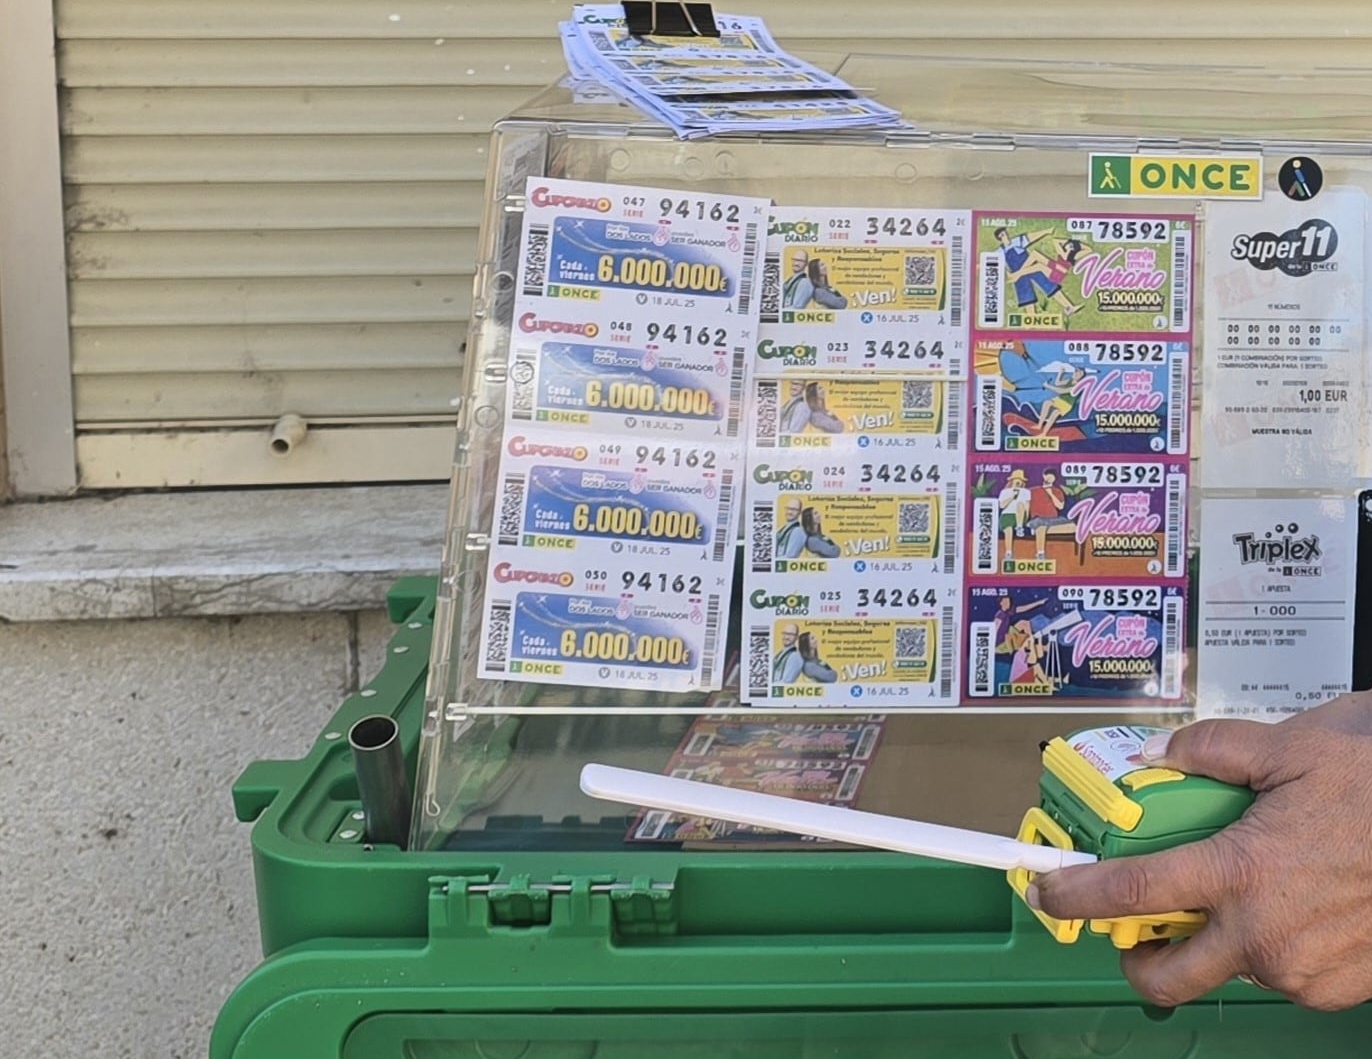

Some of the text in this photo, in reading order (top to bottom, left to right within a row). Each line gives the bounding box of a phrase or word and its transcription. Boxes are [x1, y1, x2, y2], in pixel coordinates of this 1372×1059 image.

[1141, 163, 1250, 190] ONCE
[623, 197, 645, 206] 047
[659, 198, 739, 222] 94162
[829, 220, 851, 228] 022
[867, 217, 946, 236] 34264
[1071, 221, 1092, 229] 087
[1099, 222, 1166, 240] 78592
[598, 255, 728, 292] 6.000.000€
[1073, 248, 1166, 299] Verano
[562, 288, 599, 299] ONCE
[851, 288, 897, 307] ¡Ven!
[797, 314, 832, 322] ONCE
[1024, 317, 1059, 325] ONCE
[610, 321, 632, 331] 048
[1228, 325, 1341, 333] 00 00 00 00 00 00
[647, 323, 727, 347] 94162
[828, 343, 848, 352] 023
[864, 341, 944, 359] 34264
[1068, 343, 1089, 351] 088
[1095, 344, 1163, 361] 78592
[586, 380, 716, 415] 6.000.000€
[1072, 370, 1163, 420] Verano
[1300, 390, 1347, 403] 1,00 EUR
[551, 412, 588, 423] ONCE
[849, 412, 894, 431] ¡Ven!
[794, 436, 829, 446] ONCE
[1021, 439, 1056, 448] ONCE
[600, 444, 621, 454] 049
[635, 446, 716, 469] 94162
[823, 467, 845, 476] 024
[861, 465, 940, 482] 34264
[1065, 466, 1086, 474] 089
[1093, 466, 1160, 483] 78592
[573, 503, 704, 541] 6.000.000€
[1067, 491, 1161, 544] Verano
[537, 537, 574, 548] ONCE
[844, 536, 891, 556] ¡Ven!
[790, 562, 825, 571] ONCE
[1018, 562, 1052, 571] ONCE
[1294, 567, 1320, 575] ONCE
[585, 570, 607, 581] 050
[621, 571, 702, 595] 94162
[820, 591, 841, 600] 025
[857, 589, 937, 607] 34264
[1062, 589, 1083, 597] 090
[1089, 589, 1157, 607] 78592
[1254, 606, 1296, 615] 1 000
[1064, 615, 1158, 668] Verano
[561, 629, 691, 666] 6.000.000€
[524, 663, 561, 675] ONCE
[841, 661, 887, 681] ¡Ven!
[786, 687, 821, 696] ONCE
[1015, 685, 1049, 694] ONCE
[1295, 692, 1321, 700] 0,50
